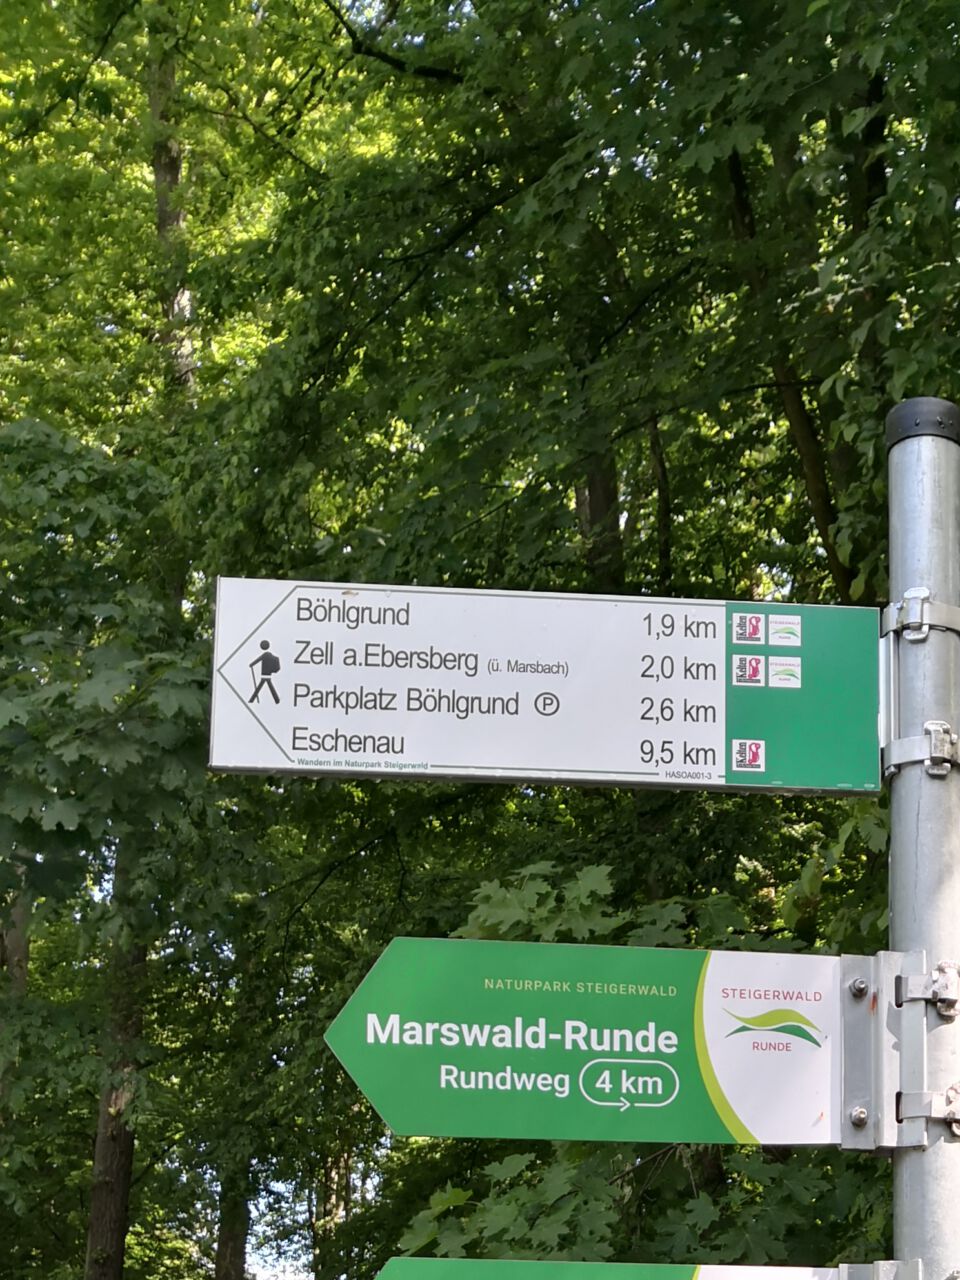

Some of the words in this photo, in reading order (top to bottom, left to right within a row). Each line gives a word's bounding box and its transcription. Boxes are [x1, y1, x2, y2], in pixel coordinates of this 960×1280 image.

[296, 597, 410, 630] Böhlgrund
[642, 613, 676, 640] 1,9
[684, 615, 717, 638] km
[294, 640, 333, 666] Zell
[343, 642, 478, 677] a.Ebersberg
[507, 660, 569, 677] Marsbach)
[641, 655, 674, 683] 2,0
[684, 657, 716, 680] km
[293, 683, 397, 714] Parkplatz
[407, 687, 519, 719] Böhlgrund
[640, 698, 674, 725] 2,6
[684, 699, 716, 722] km
[292, 726, 405, 755] Eschenau
[640, 740, 674, 768] 9,5
[683, 742, 716, 765] km
[345, 760, 381, 768] Naturpark
[384, 761, 428, 769] Steigerwald
[484, 978, 571, 992] NATURPARK
[576, 983, 677, 997] STEIGERWALD
[722, 987, 823, 1002] STEIGERWALD
[366, 1014, 678, 1053] Marswald-Runde
[752, 1042, 792, 1052] RUNDE
[440, 1065, 570, 1097] Rundweg
[596, 1070, 612, 1093] 4
[621, 1070, 663, 1094] km
